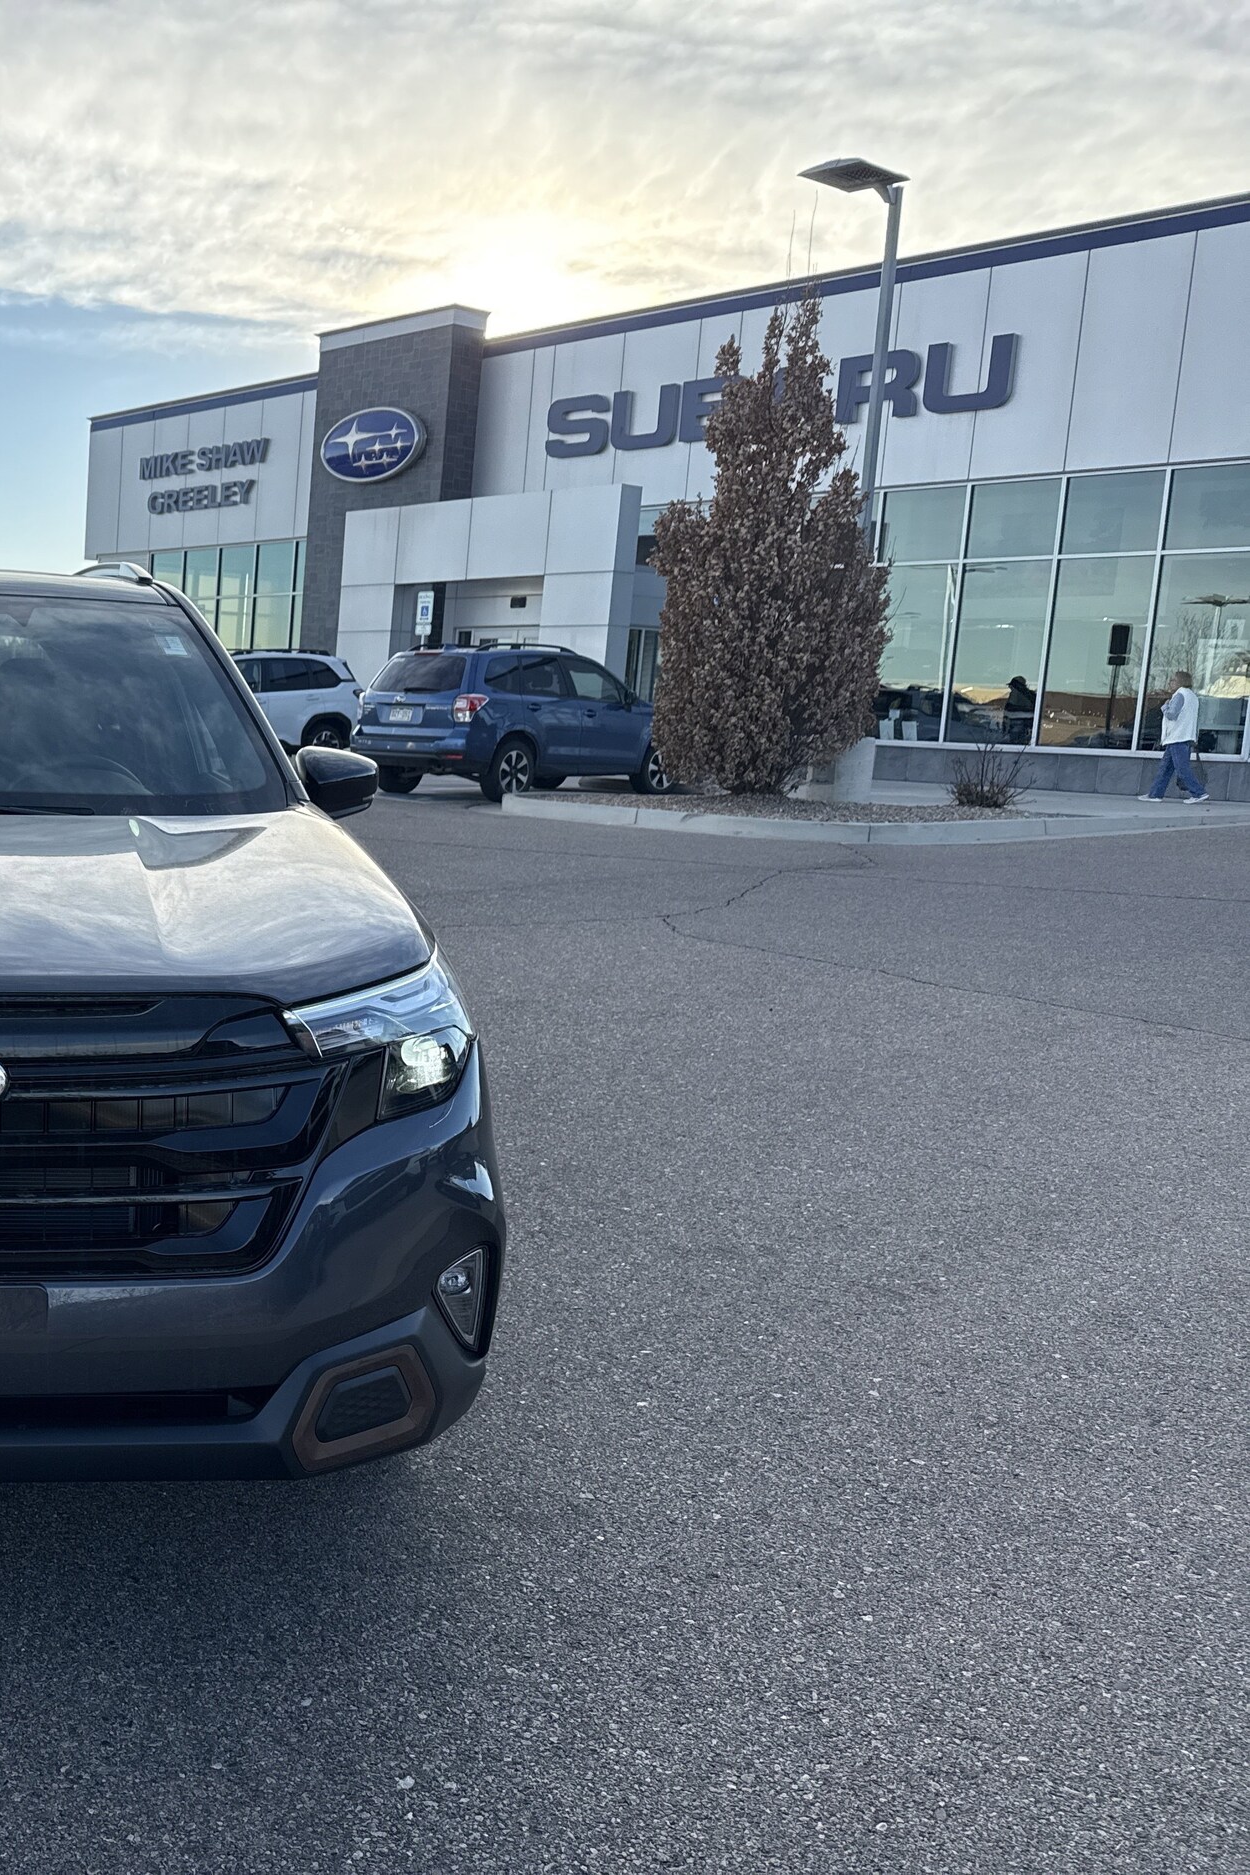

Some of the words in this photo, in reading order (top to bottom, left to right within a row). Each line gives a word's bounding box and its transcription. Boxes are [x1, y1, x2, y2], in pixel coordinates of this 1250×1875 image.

[545, 333, 1019, 458] SURU
[139, 450, 195, 480] MIKE
[196, 437, 270, 472] SHAW
[147, 479, 256, 515] GREELEY
